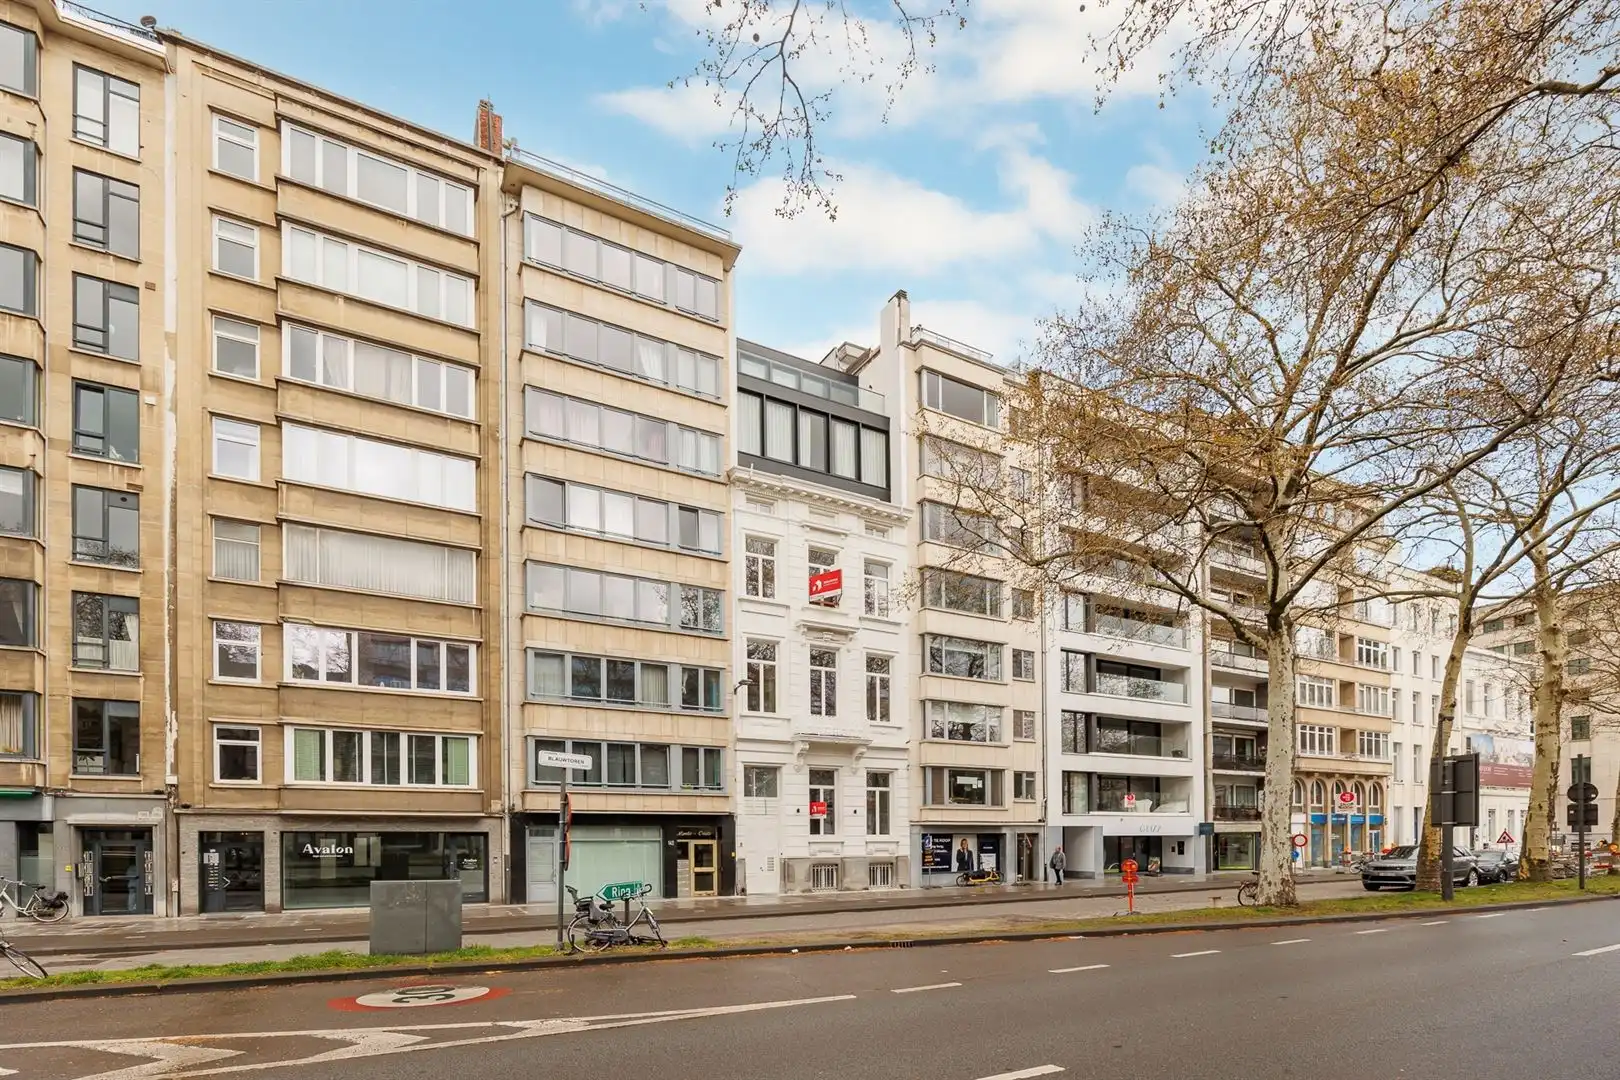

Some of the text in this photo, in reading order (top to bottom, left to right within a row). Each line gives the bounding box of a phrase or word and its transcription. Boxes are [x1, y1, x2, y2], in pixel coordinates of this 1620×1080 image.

[547, 756, 585, 765] BLAUWTOREN
[302, 843, 353, 854] Avalon
[611, 886, 631, 899] Ring
